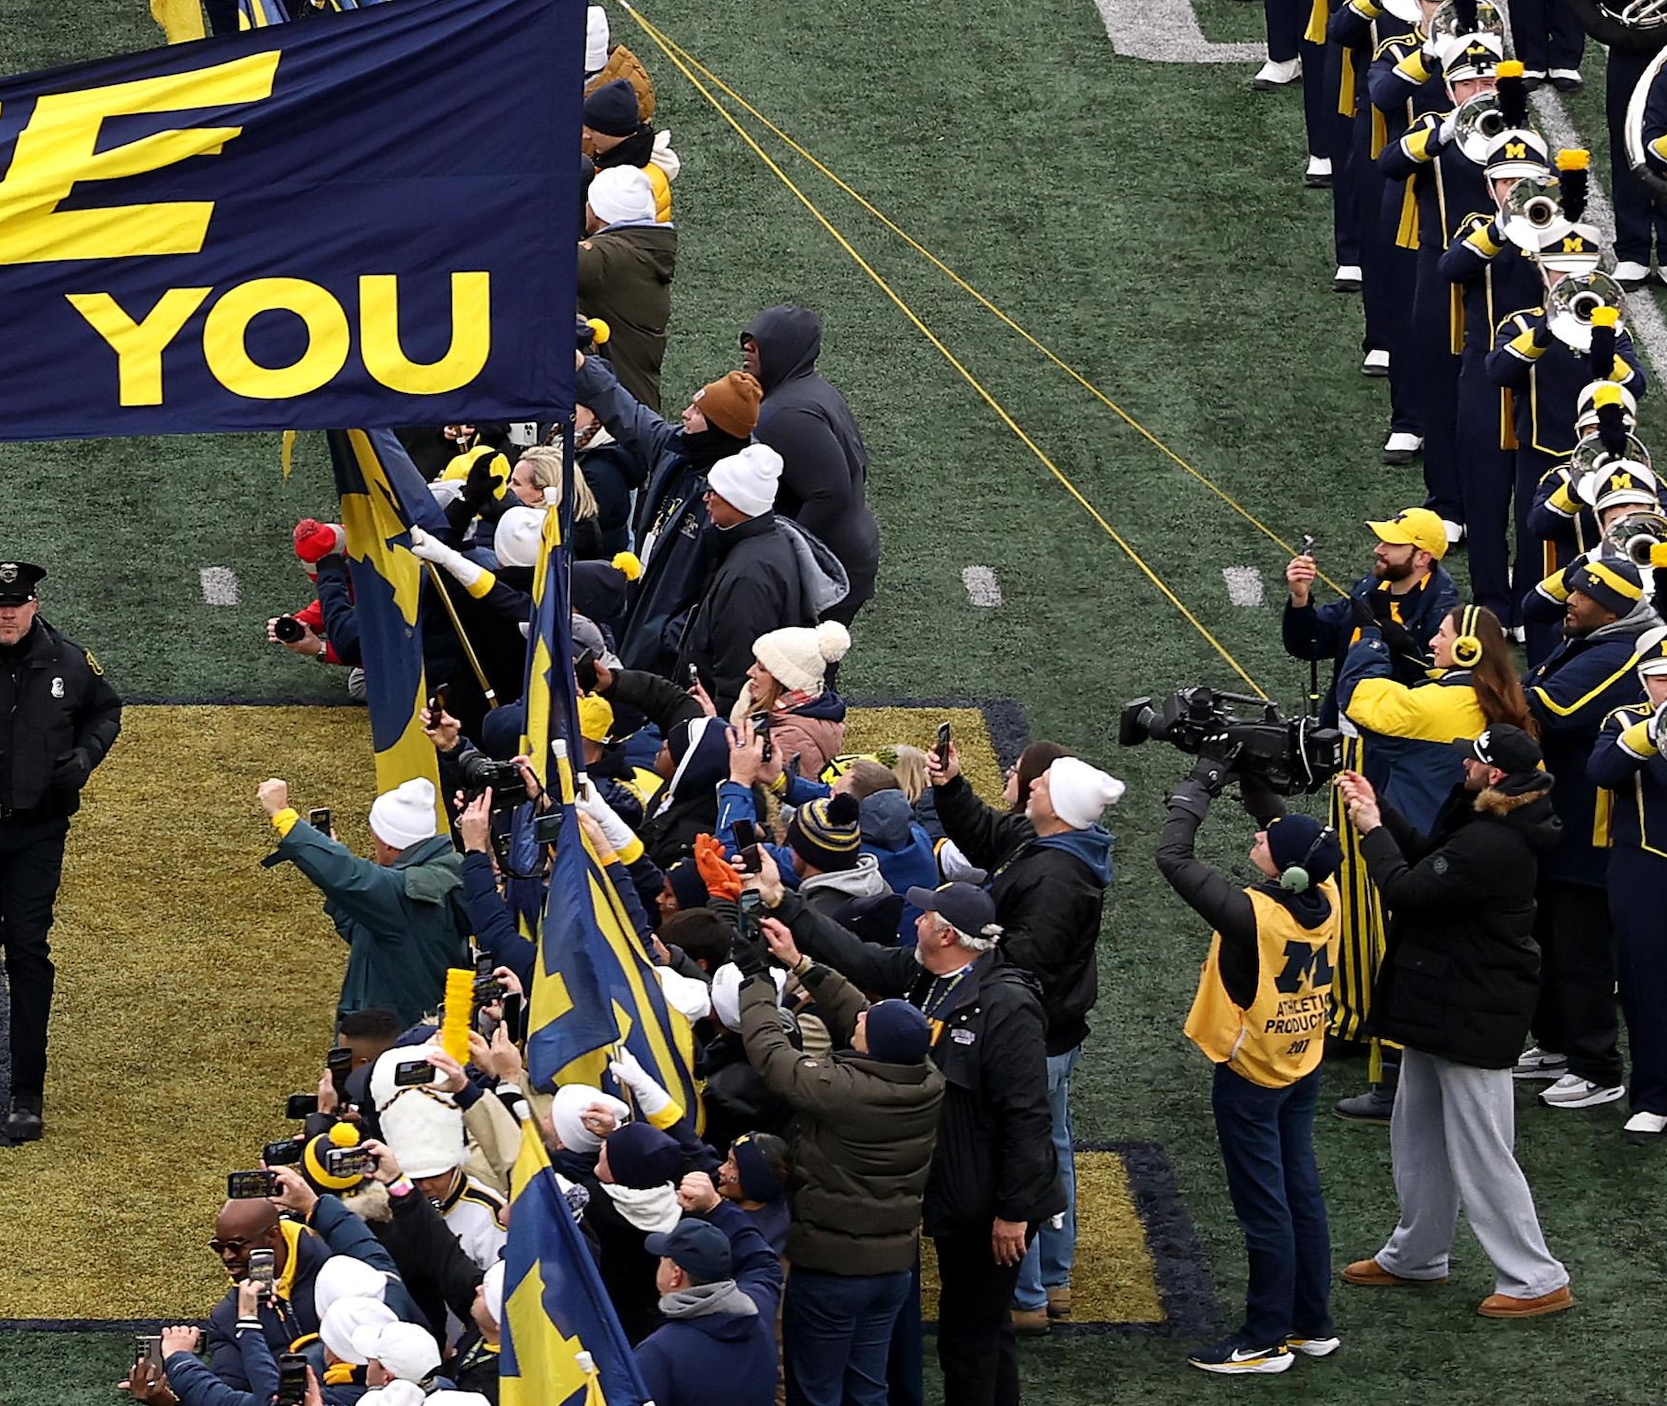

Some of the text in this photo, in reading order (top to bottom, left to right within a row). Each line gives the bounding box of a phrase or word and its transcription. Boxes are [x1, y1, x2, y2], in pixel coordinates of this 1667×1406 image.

[1504, 142, 1527, 158] M
[1562, 236, 1584, 254] M
[67, 272, 490, 406] YOU
[1611, 472, 1633, 491] M
[1275, 941, 1334, 994] M
[1264, 1012, 1325, 1035] PRODUCT
[1286, 1038, 1310, 1056] 207
